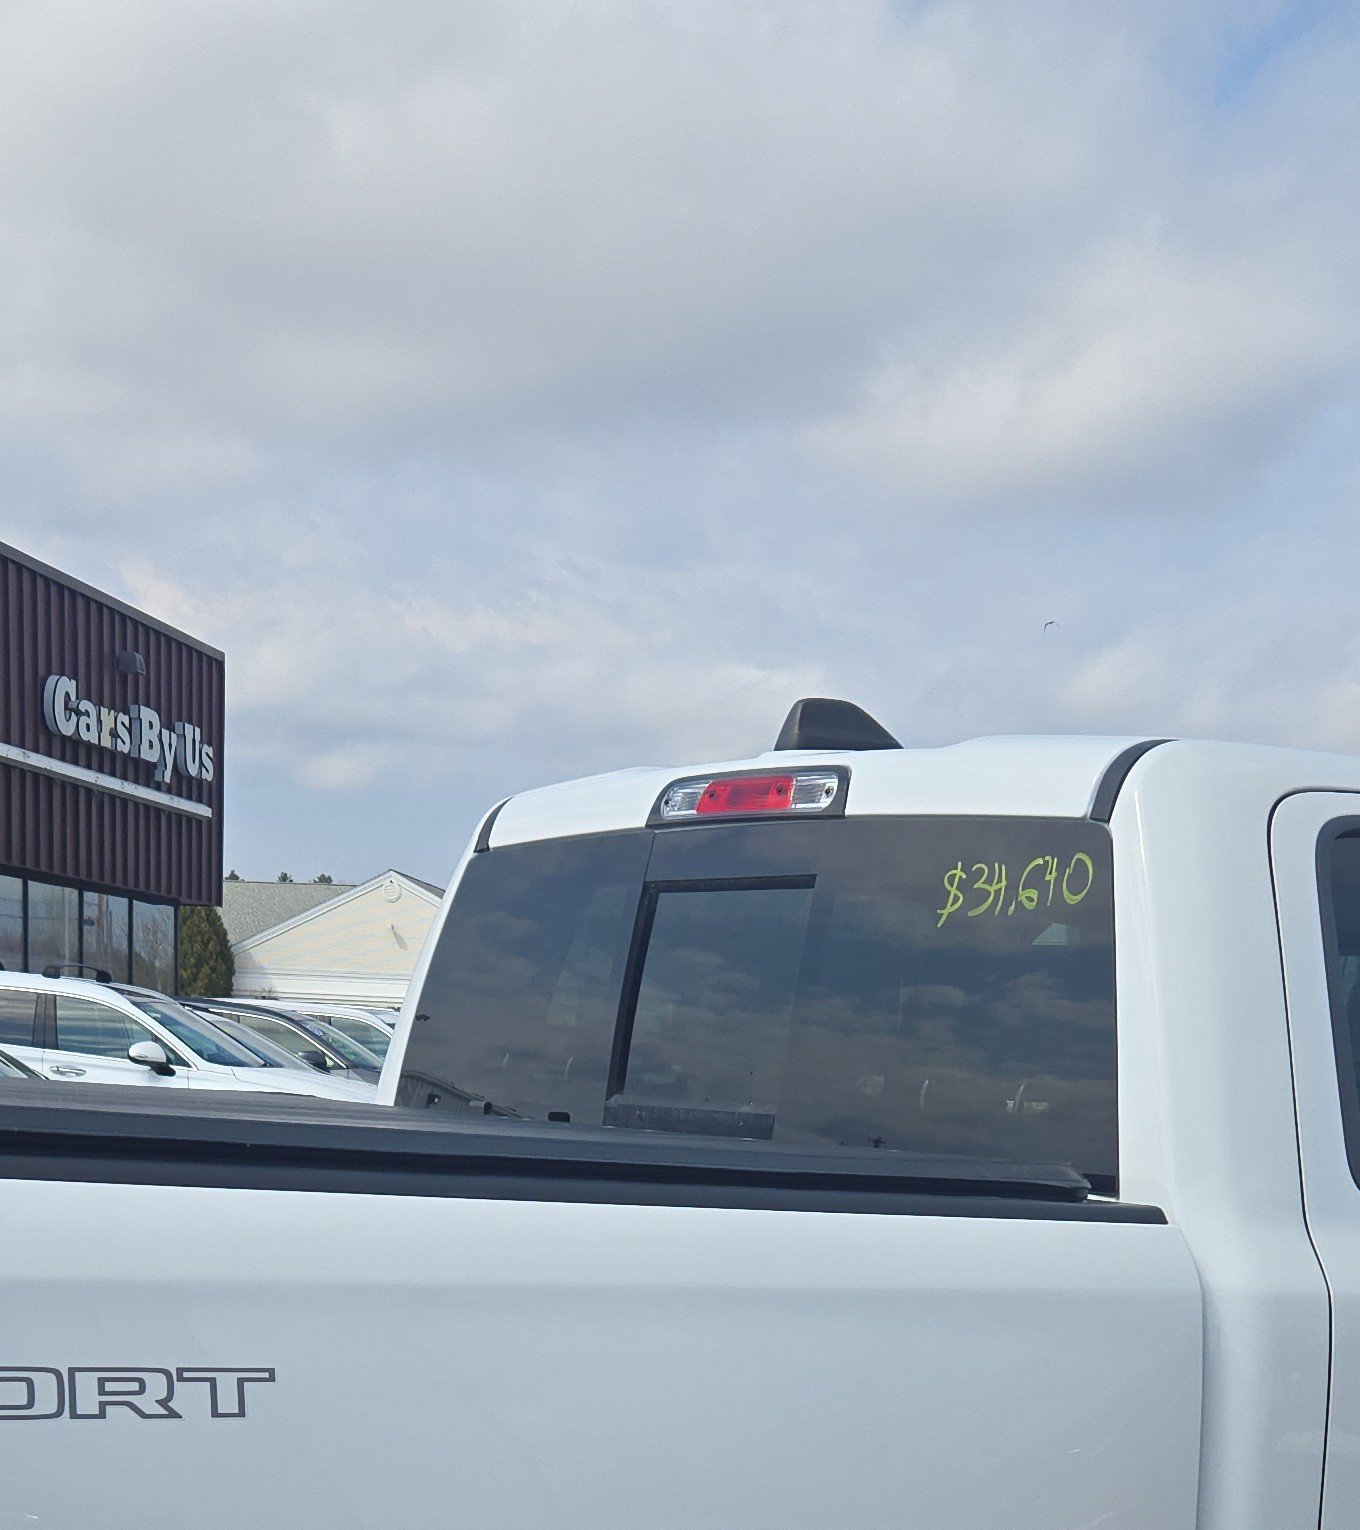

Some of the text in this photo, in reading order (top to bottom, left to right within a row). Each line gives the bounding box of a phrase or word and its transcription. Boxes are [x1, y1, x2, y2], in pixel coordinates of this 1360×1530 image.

[43, 675, 214, 783] Cars By Us
[937, 852, 1094, 928] $34,640
